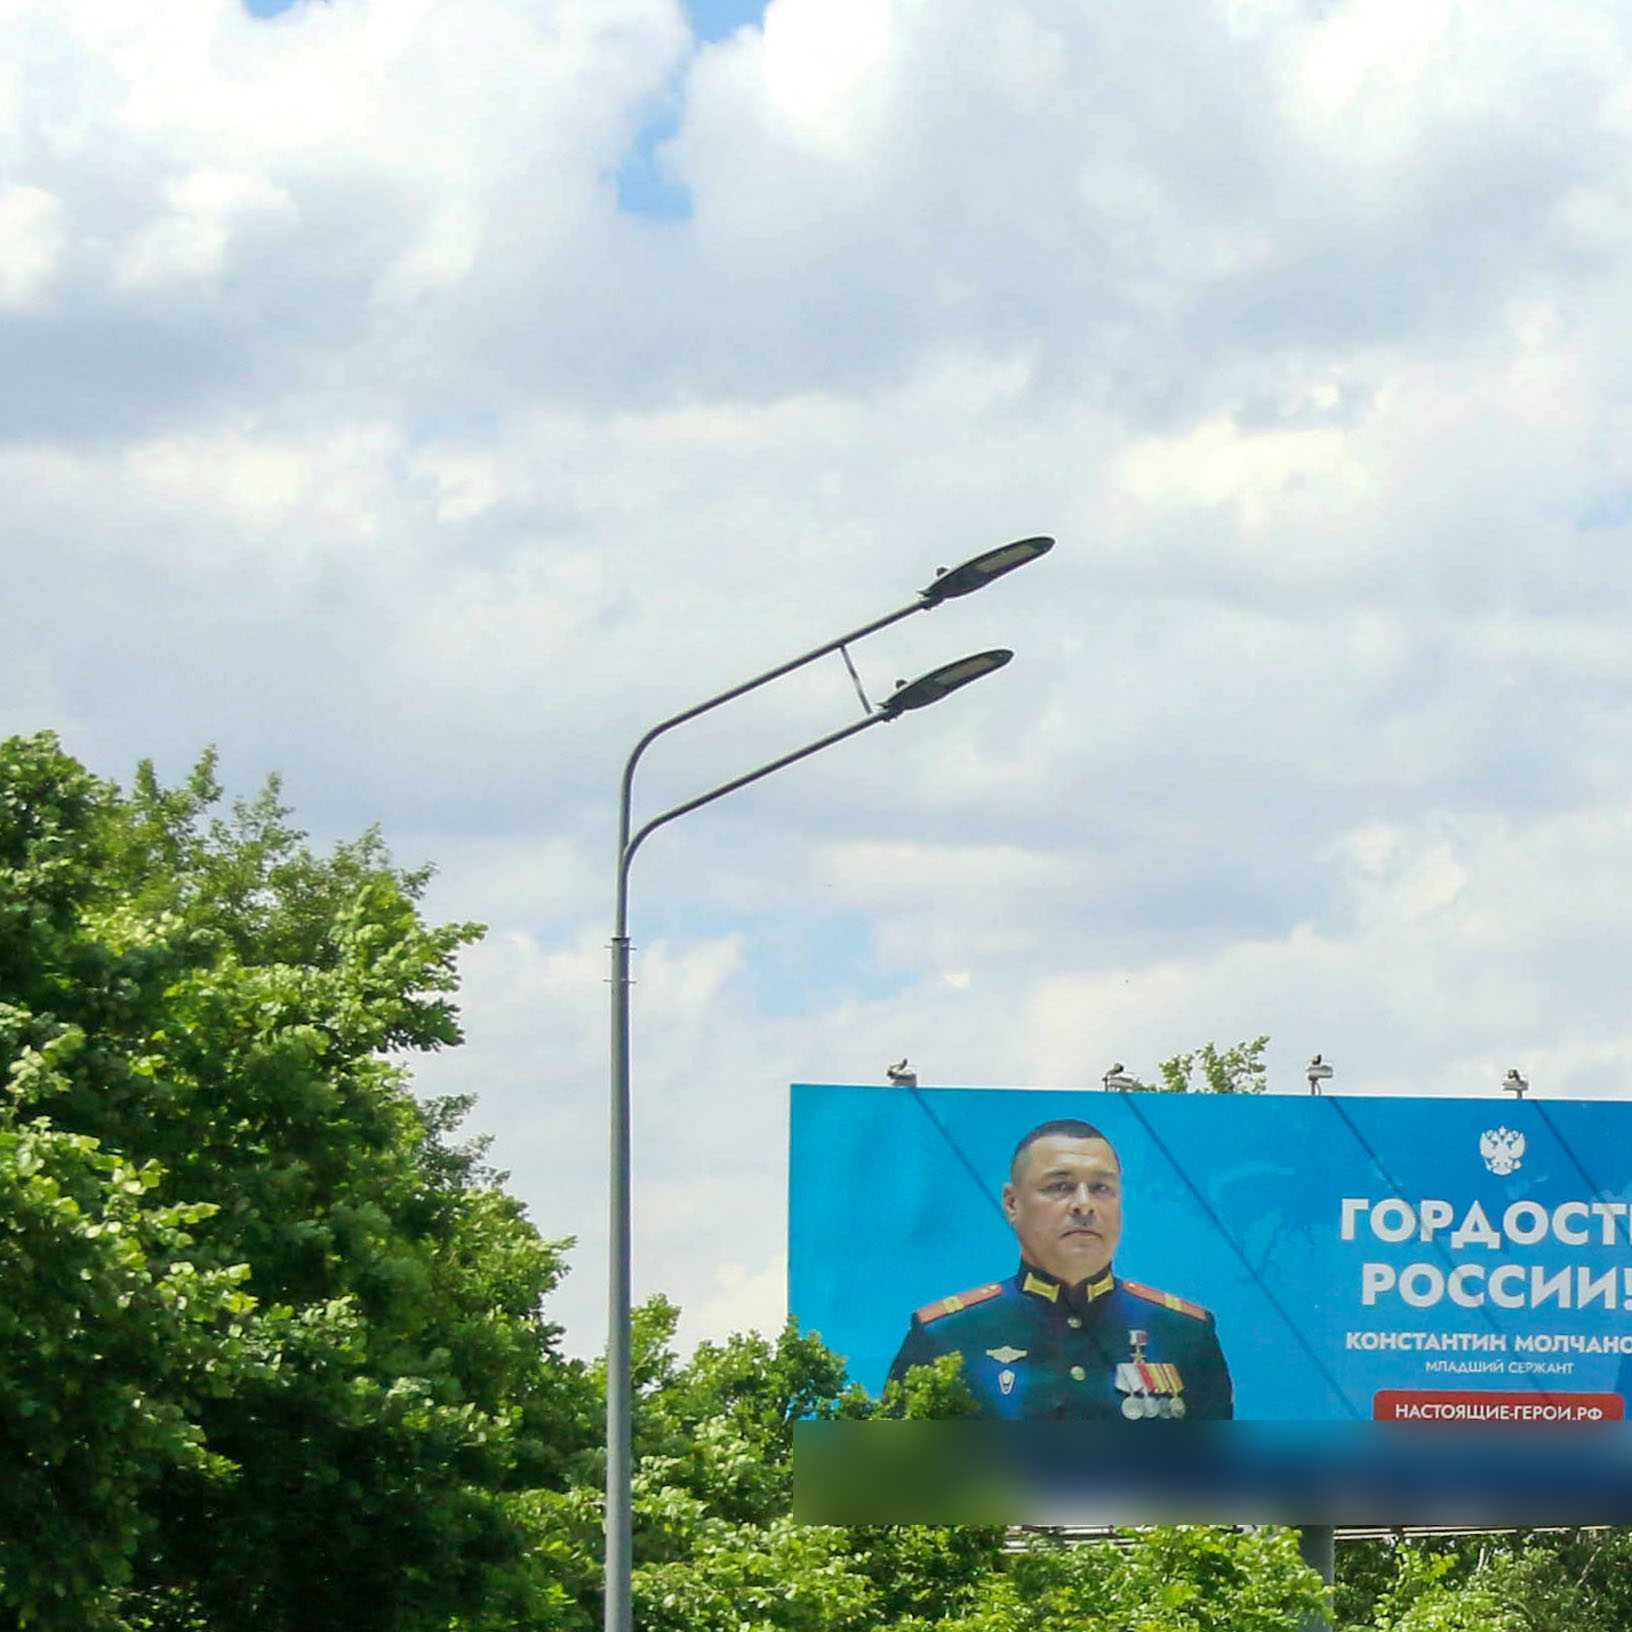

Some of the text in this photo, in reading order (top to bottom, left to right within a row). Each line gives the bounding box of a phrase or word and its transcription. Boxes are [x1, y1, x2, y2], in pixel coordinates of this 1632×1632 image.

[1344, 1331, 1506, 1353] КОНСТАНТИН
[1425, 1359, 1575, 1376] МЛАДШИЙ СЕРЖАНТ
[1395, 1404, 1603, 1421] НАСТОЯЩИЕ-ГЕРОИ.РФ
